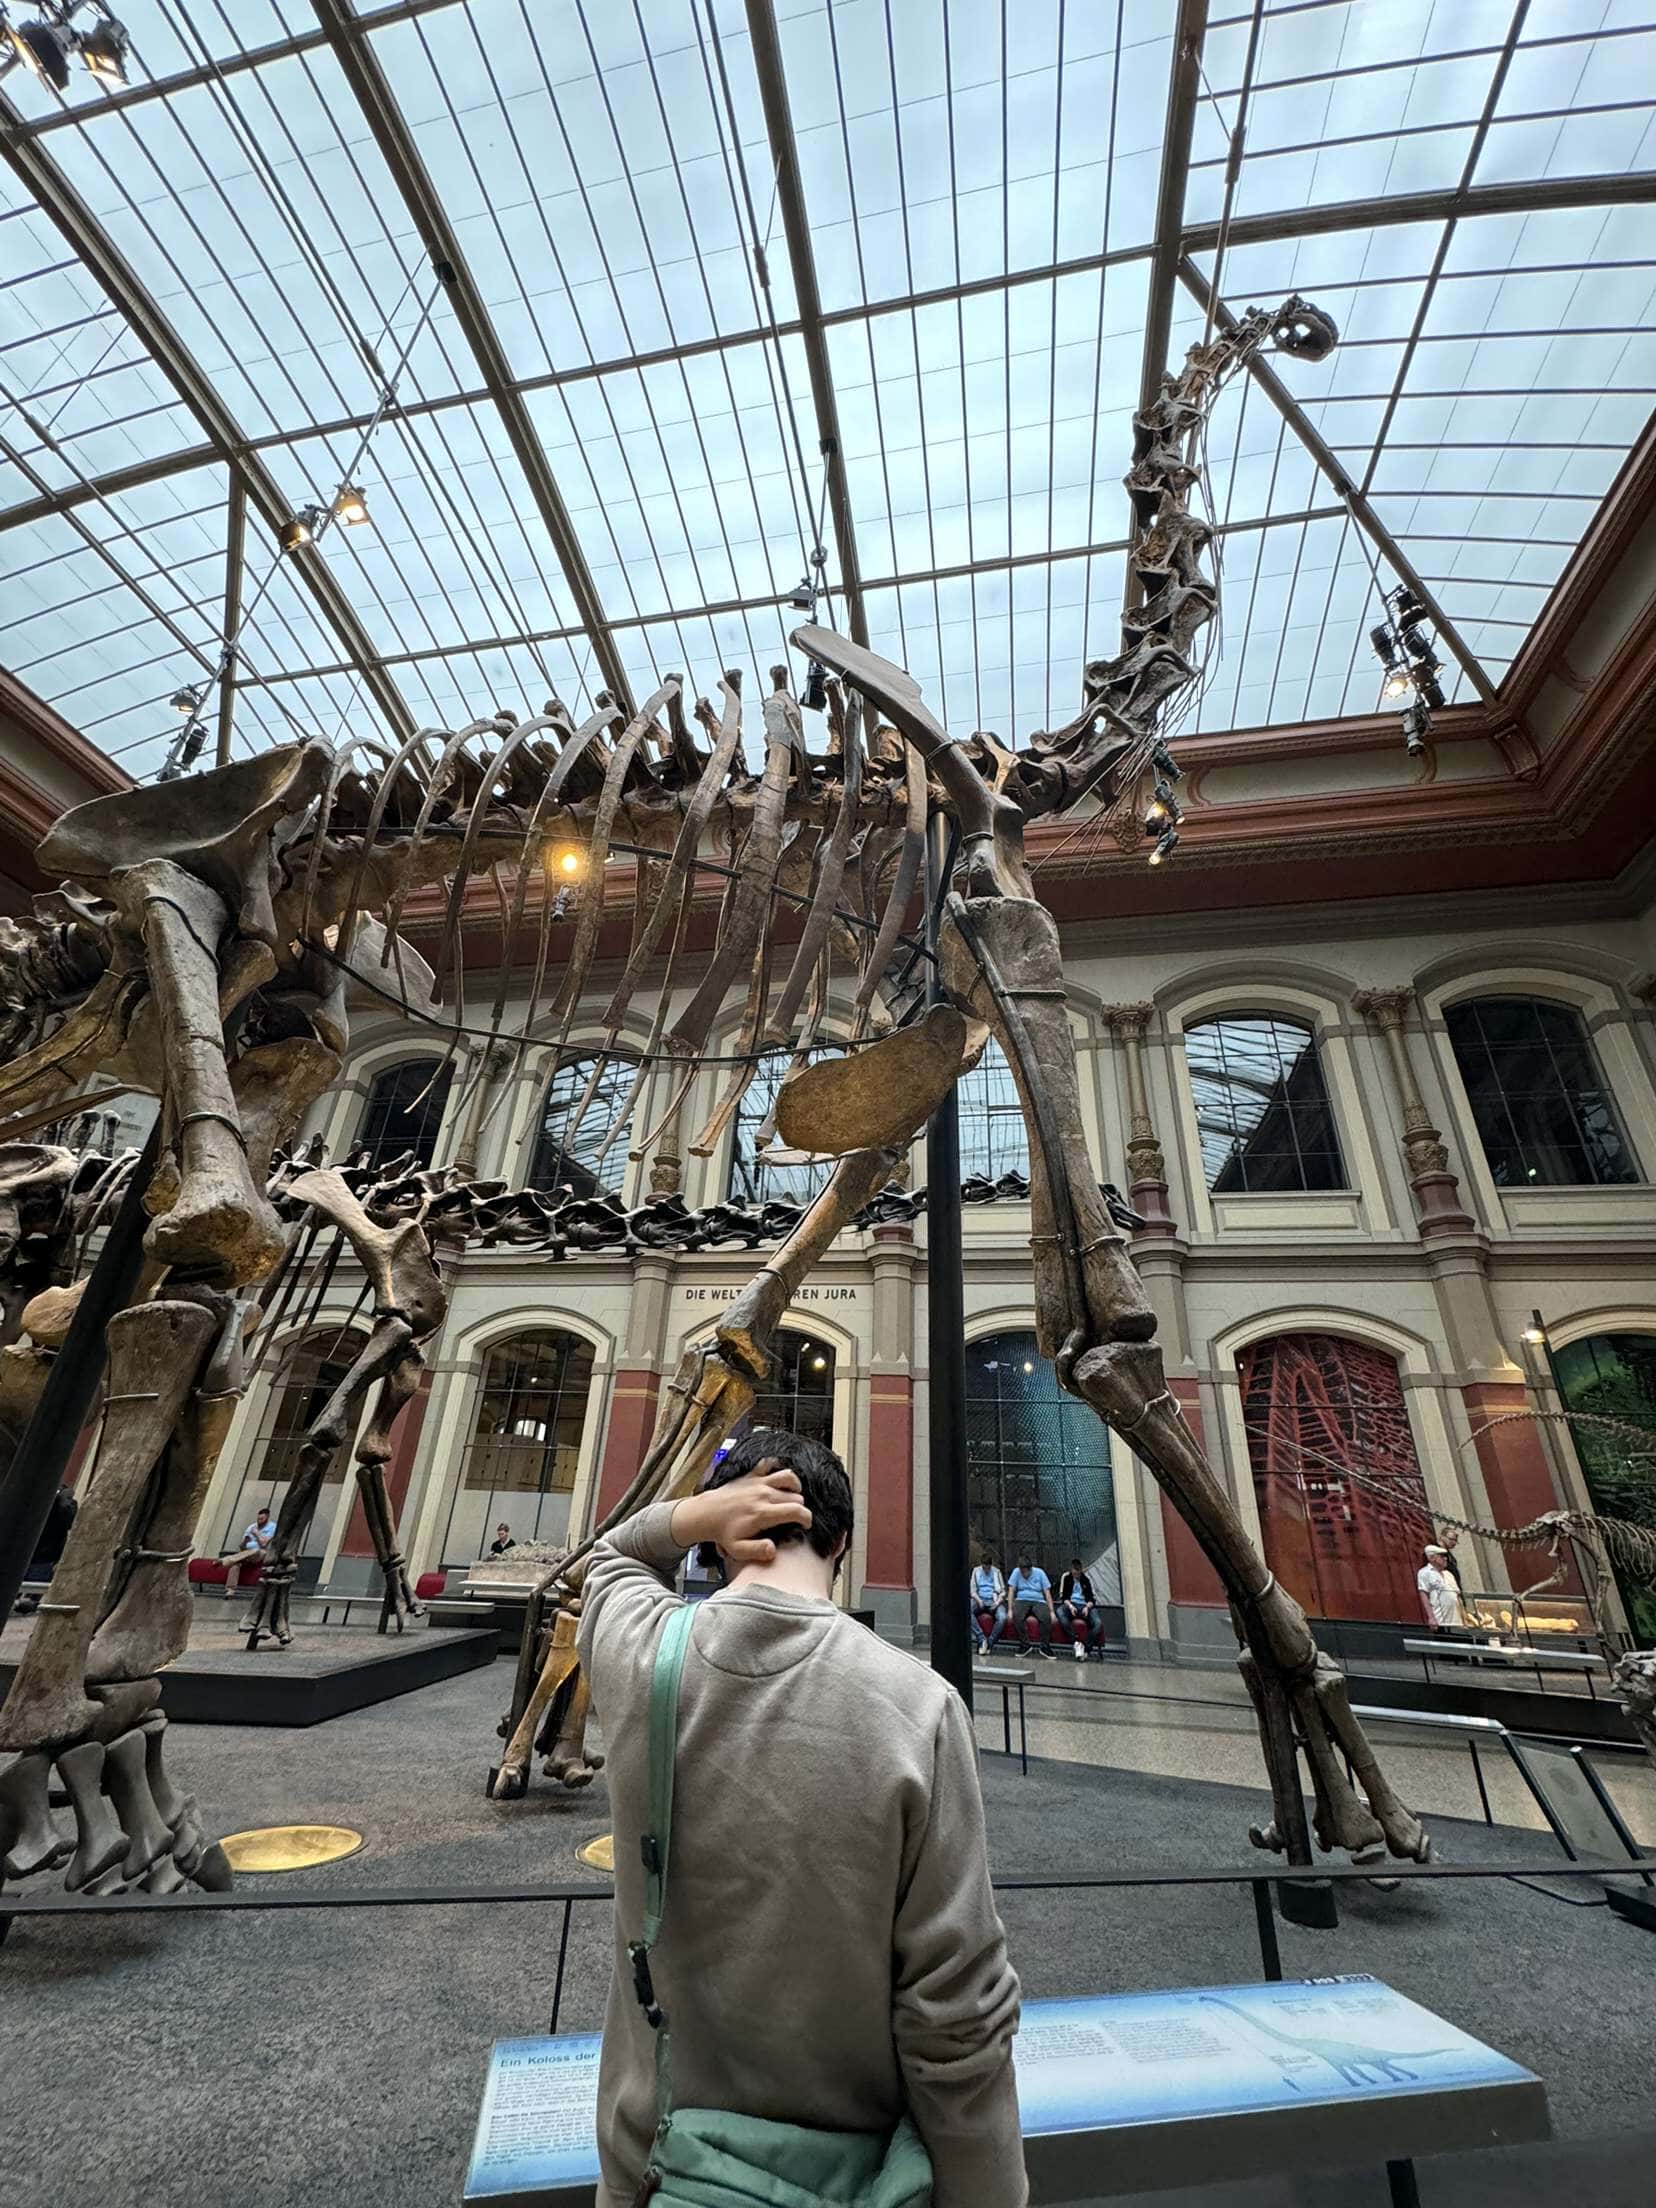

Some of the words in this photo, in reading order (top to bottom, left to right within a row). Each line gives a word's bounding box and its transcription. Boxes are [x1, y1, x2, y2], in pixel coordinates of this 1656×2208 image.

[686, 1289, 706, 1300] DIE
[711, 1289, 743, 1300] WELT
[824, 1289, 857, 1299] JURA
[500, 2058, 522, 2068] Ein
[528, 2055, 571, 2065] Koloss
[575, 2052, 597, 2061] der
